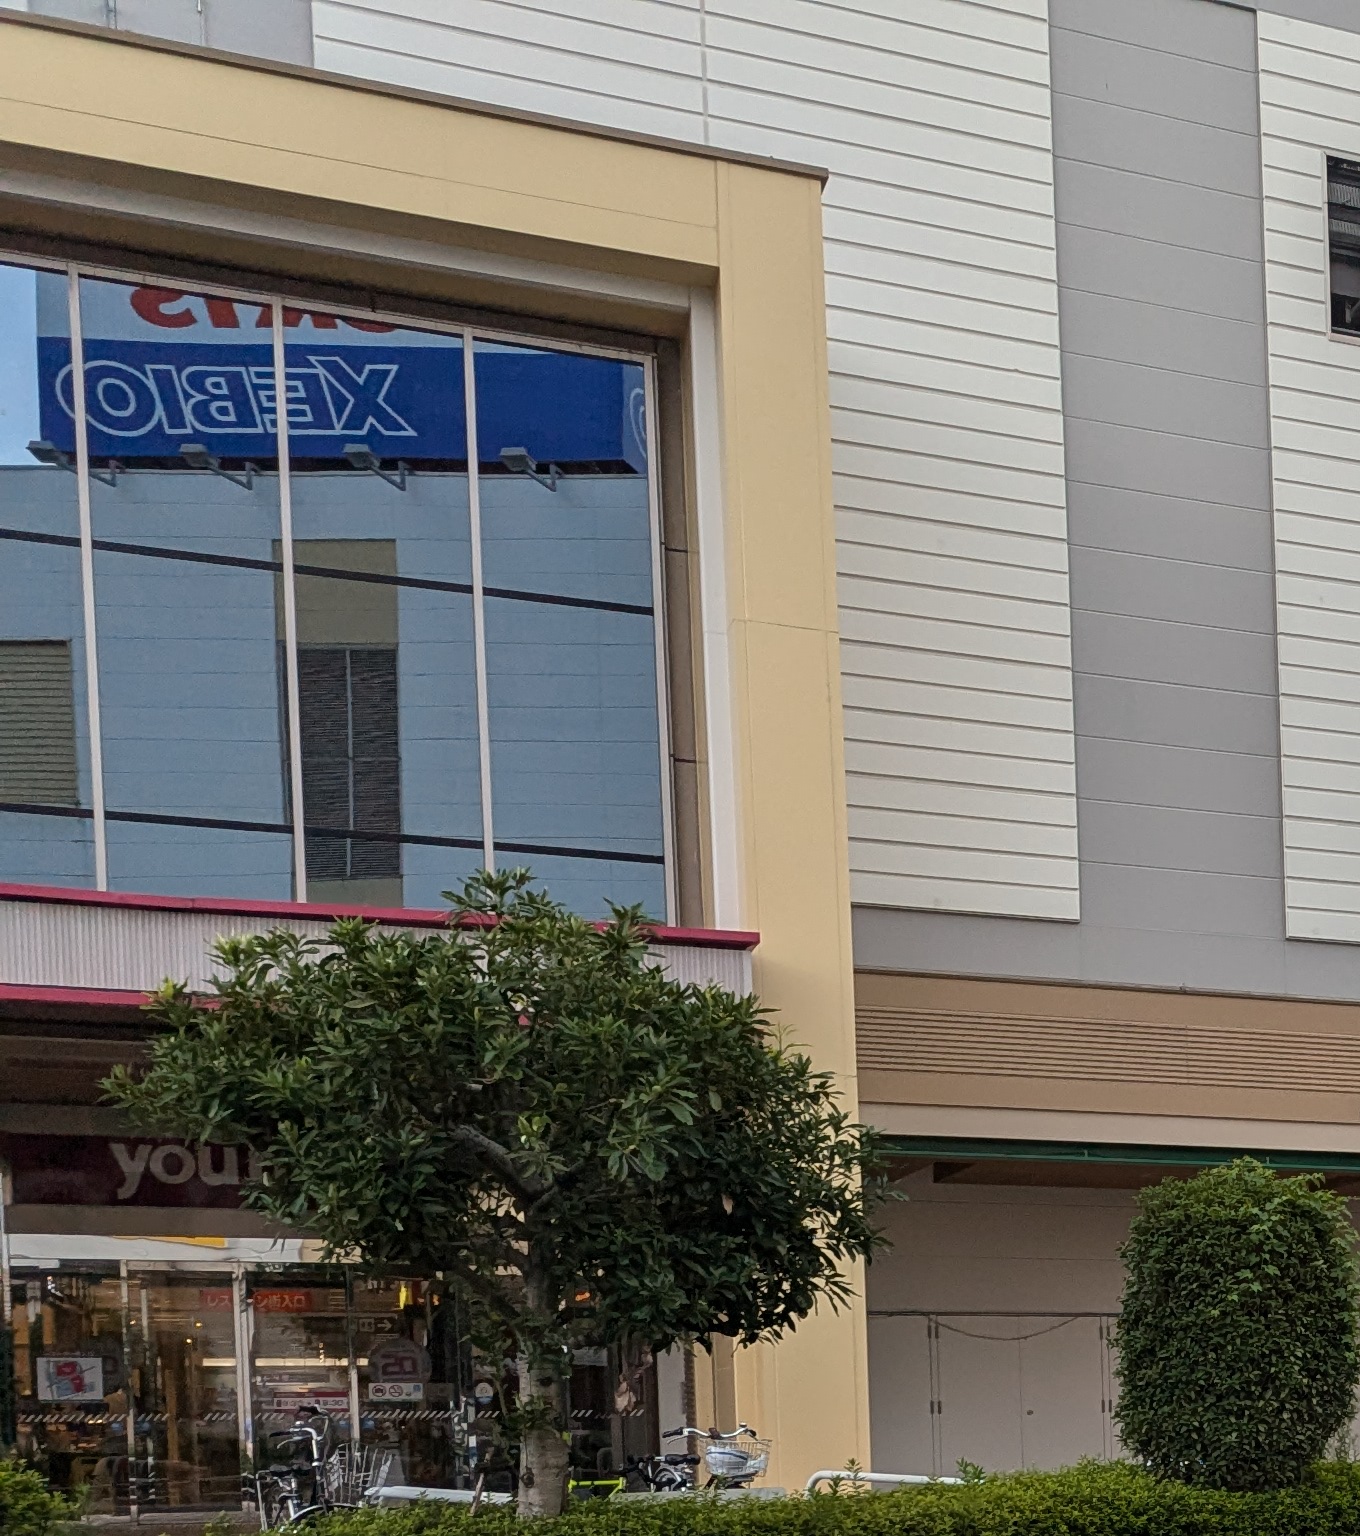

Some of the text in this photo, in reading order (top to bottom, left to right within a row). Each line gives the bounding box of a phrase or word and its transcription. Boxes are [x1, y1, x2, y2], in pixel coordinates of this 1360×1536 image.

[206, 1293, 306, 1308] レスン街入口
